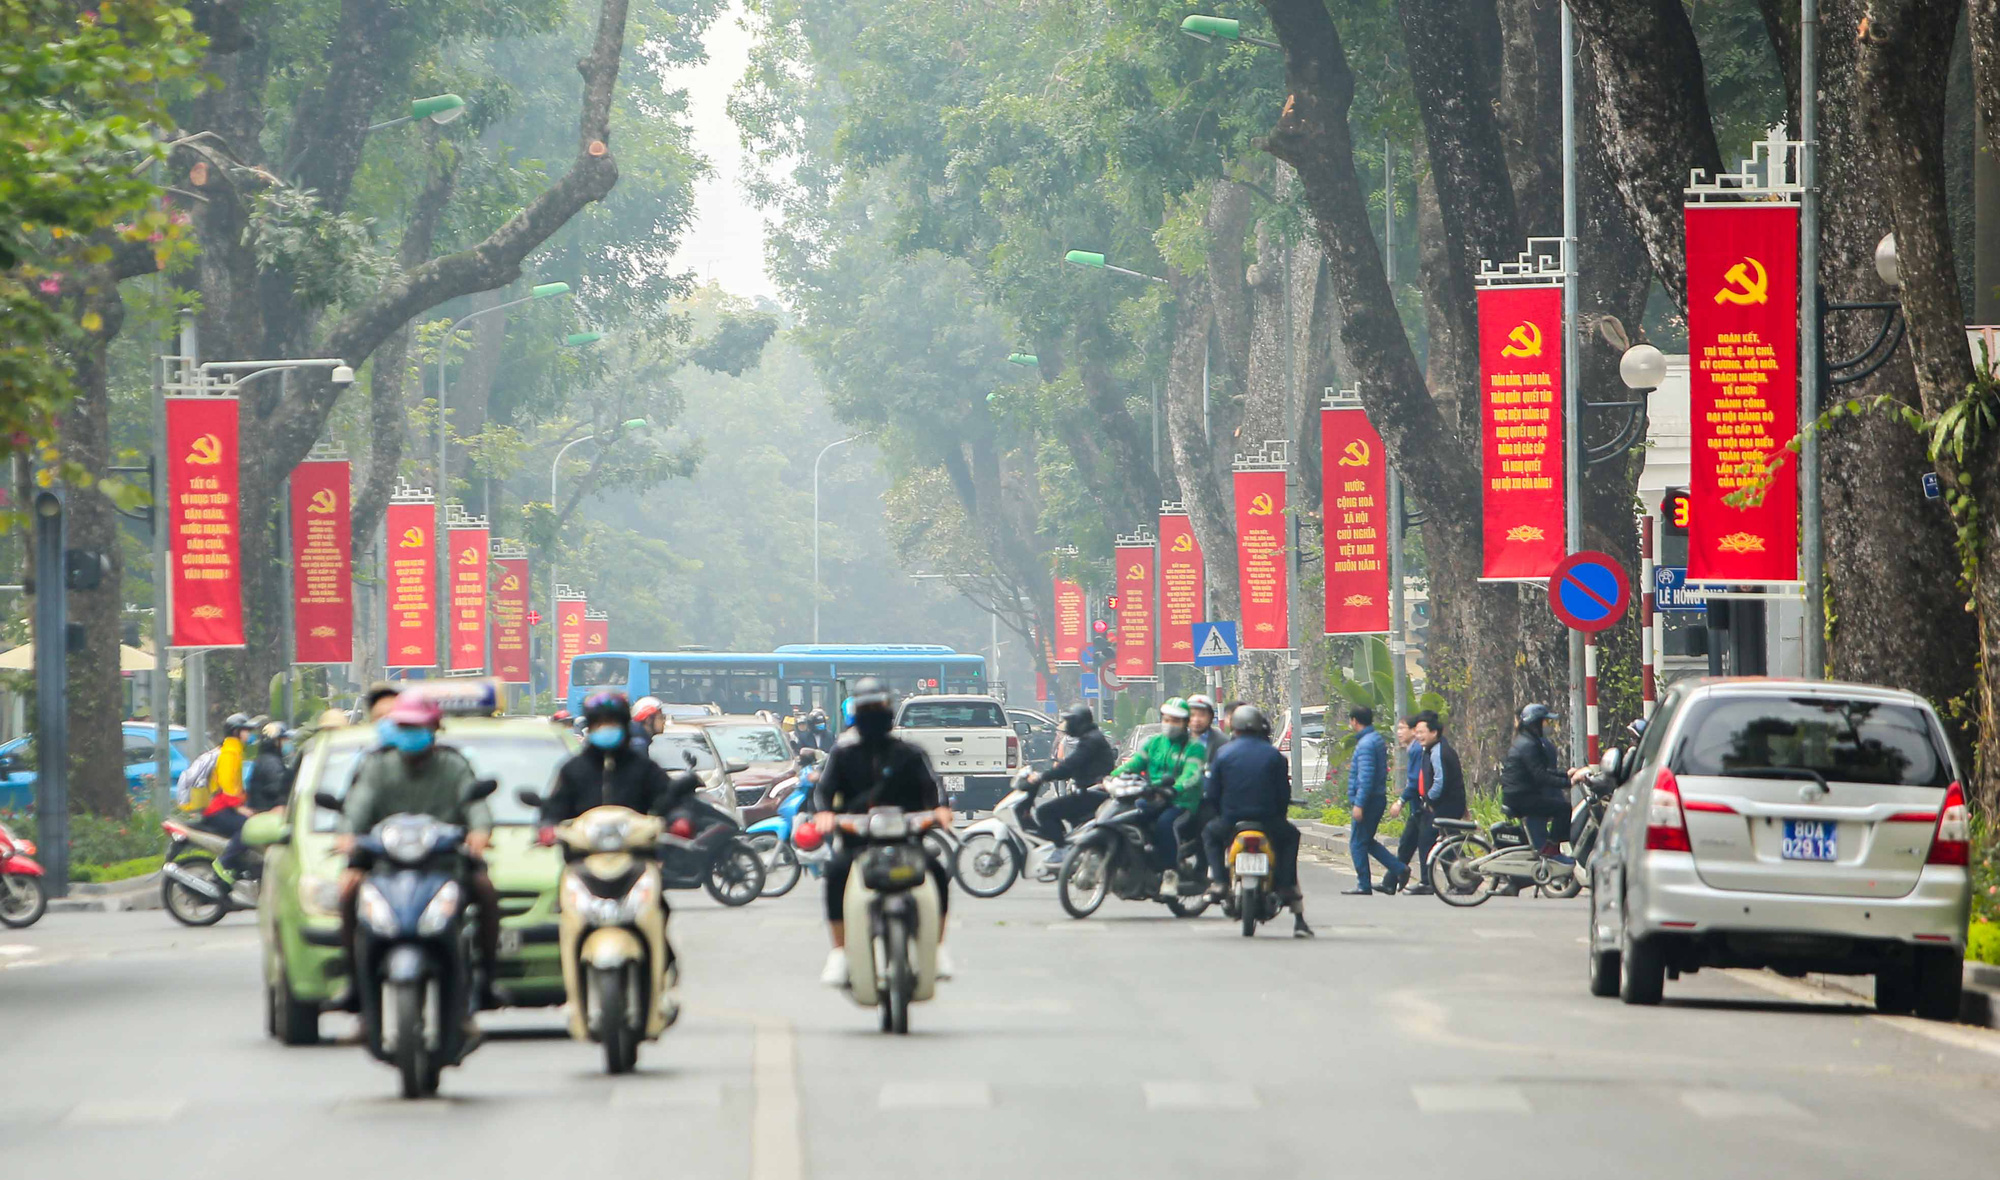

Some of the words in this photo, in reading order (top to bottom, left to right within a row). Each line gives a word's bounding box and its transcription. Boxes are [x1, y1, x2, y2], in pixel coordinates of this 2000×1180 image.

[1344, 478, 1365, 492] NƯỚC
[1336, 495, 1357, 510] CỘNG
[1343, 511, 1354, 524] XÃ
[1336, 525, 1352, 540] CHỦ
[1339, 543, 1355, 558] VIỆT
[1356, 544, 1374, 555] NAM
[1659, 586, 1671, 604] LÊ
[1794, 820, 1824, 838] 80A
[1782, 838, 1837, 859] 029.13
